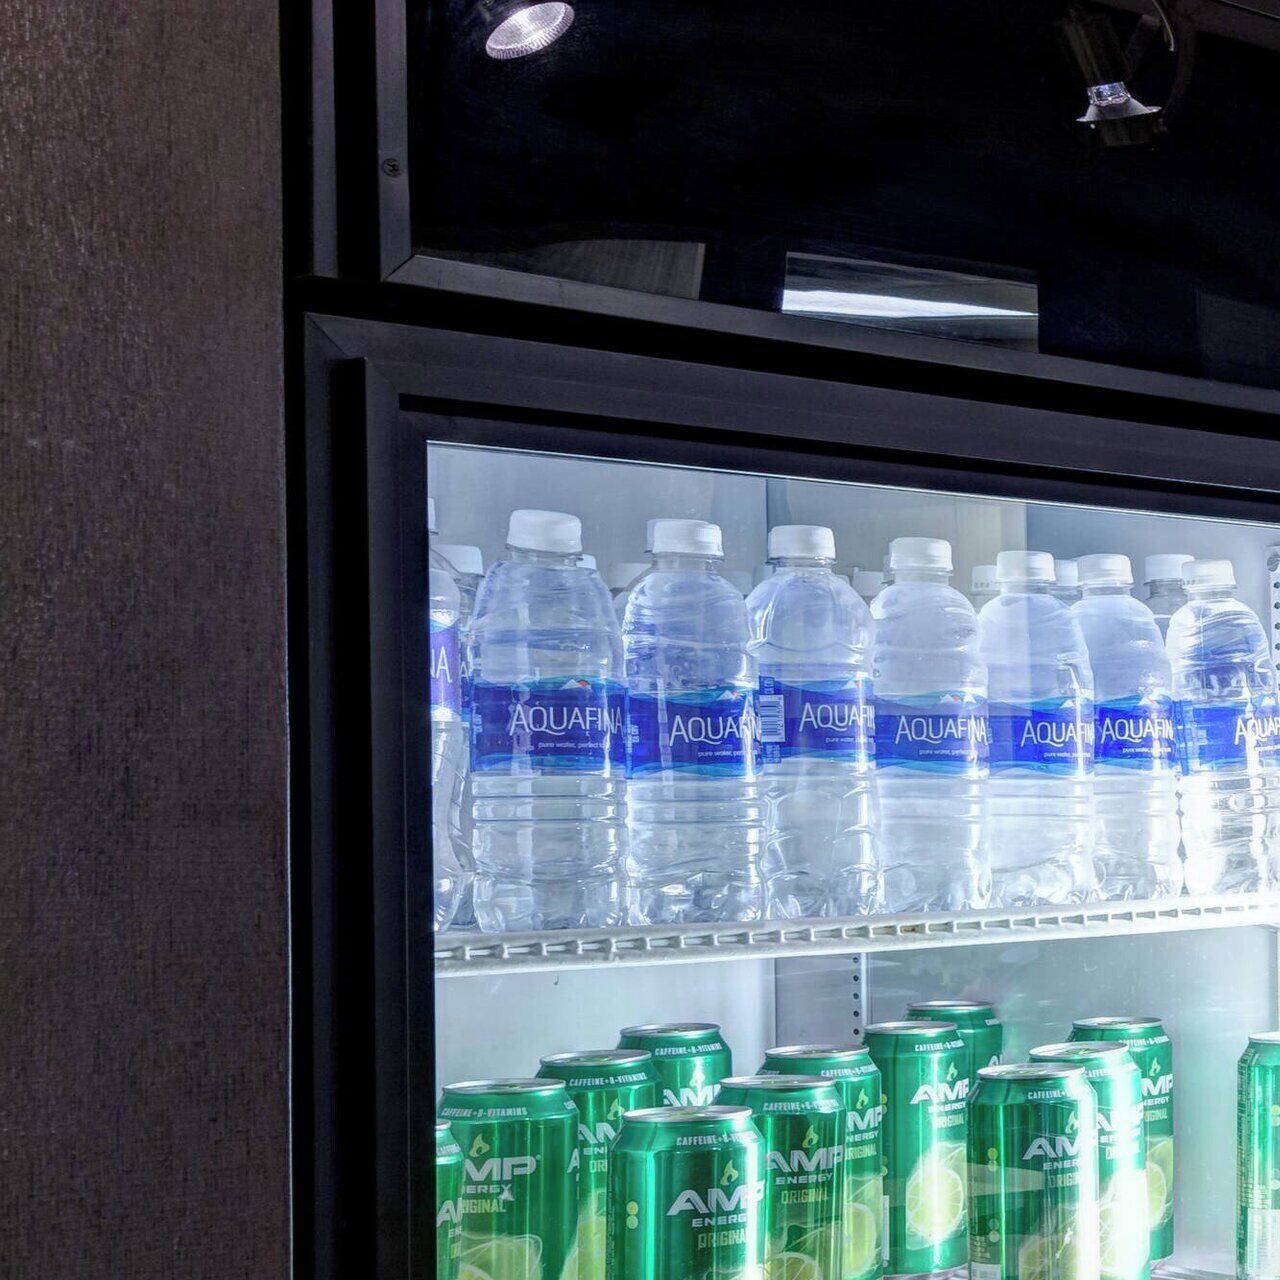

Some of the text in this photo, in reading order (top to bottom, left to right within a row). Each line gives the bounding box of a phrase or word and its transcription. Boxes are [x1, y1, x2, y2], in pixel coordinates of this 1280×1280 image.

[509, 703, 625, 737] AQUAFINA
[1141, 1073, 1174, 1097] MP
[845, 1104, 884, 1131] MP
[464, 1156, 538, 1182] MP
[765, 1144, 845, 1173] AMP
[775, 1172, 833, 1186] ENERGY
[692, 1213, 749, 1228] ENERG
